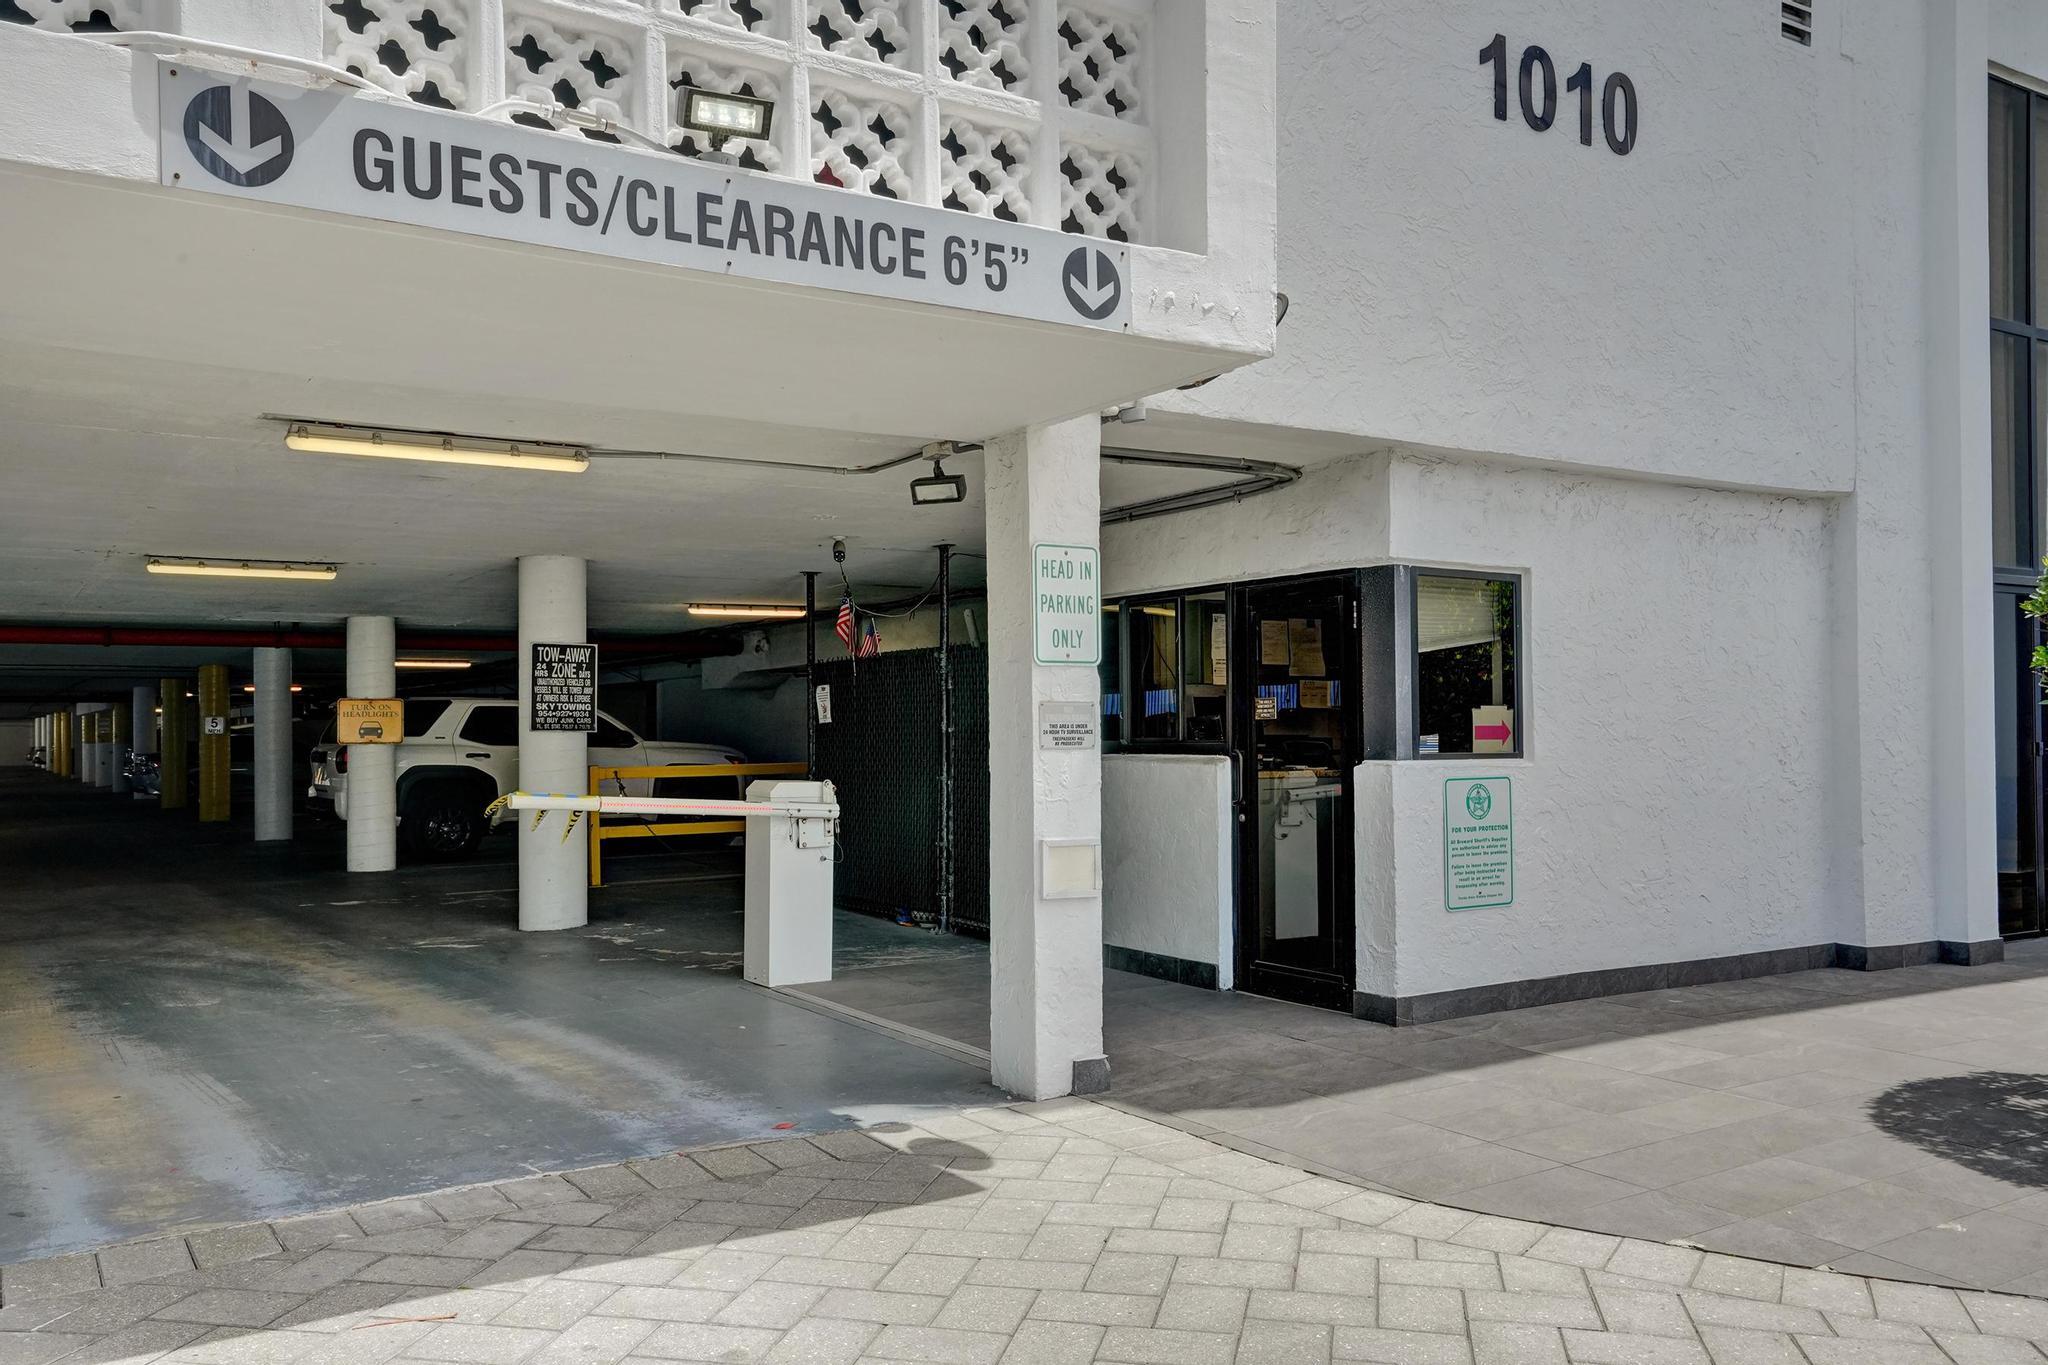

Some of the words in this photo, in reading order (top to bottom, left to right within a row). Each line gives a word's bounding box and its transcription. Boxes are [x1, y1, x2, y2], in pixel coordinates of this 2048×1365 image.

[1479, 33, 1638, 156] 1010
[352, 128, 926, 280] GUESTS/CLEARANCE
[1041, 559, 1074, 580] HEAD
[1079, 561, 1092, 580] IN
[1040, 594, 1094, 615] PARKING
[1052, 628, 1083, 649] ONLY
[537, 646, 592, 663] TOW-AWAY
[551, 663, 577, 678] ZONE
[552, 686, 562, 694] WILL
[562, 686, 569, 694] BE
[566, 678, 585, 686] VEHICLES
[584, 679, 591, 687] OR
[351, 703, 376, 711] TURN
[378, 703, 392, 711] ON
[535, 702, 555, 710] SKY
[210, 717, 218, 729] 5
